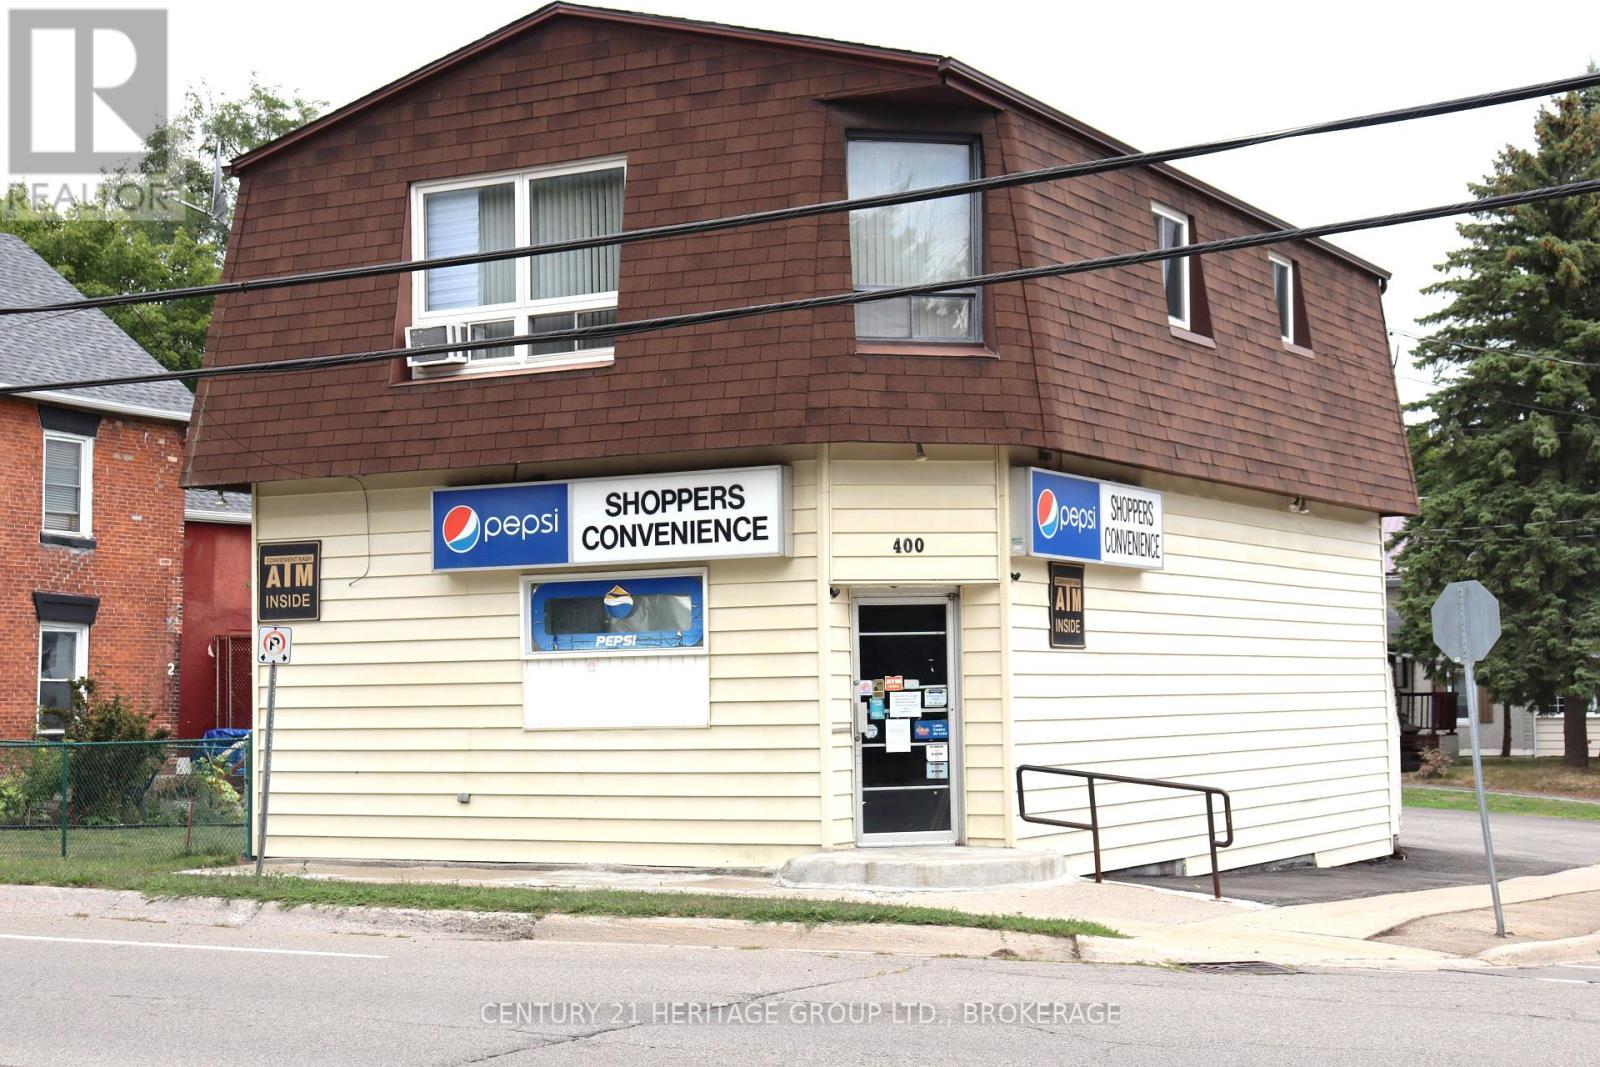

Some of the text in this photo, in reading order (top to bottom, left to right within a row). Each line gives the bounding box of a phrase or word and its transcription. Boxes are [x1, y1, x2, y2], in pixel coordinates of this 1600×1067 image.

[605, 483, 745, 518] SHOPPERS
[1110, 494, 1154, 527] SHOPPERS
[484, 508, 559, 543] pepsi
[582, 515, 769, 551] CONVENIENCE
[1060, 505, 1096, 533] pepsi
[893, 537, 924, 553] 400
[1104, 526, 1160, 559] CONVENIENCE
[265, 555, 314, 588] ATM
[265, 594, 311, 608] INSIDE
[1055, 578, 1081, 612] ATM
[595, 634, 638, 647] PEPSI
[1055, 618, 1081, 634] INSIDE
[167, 662, 175, 675] 2
